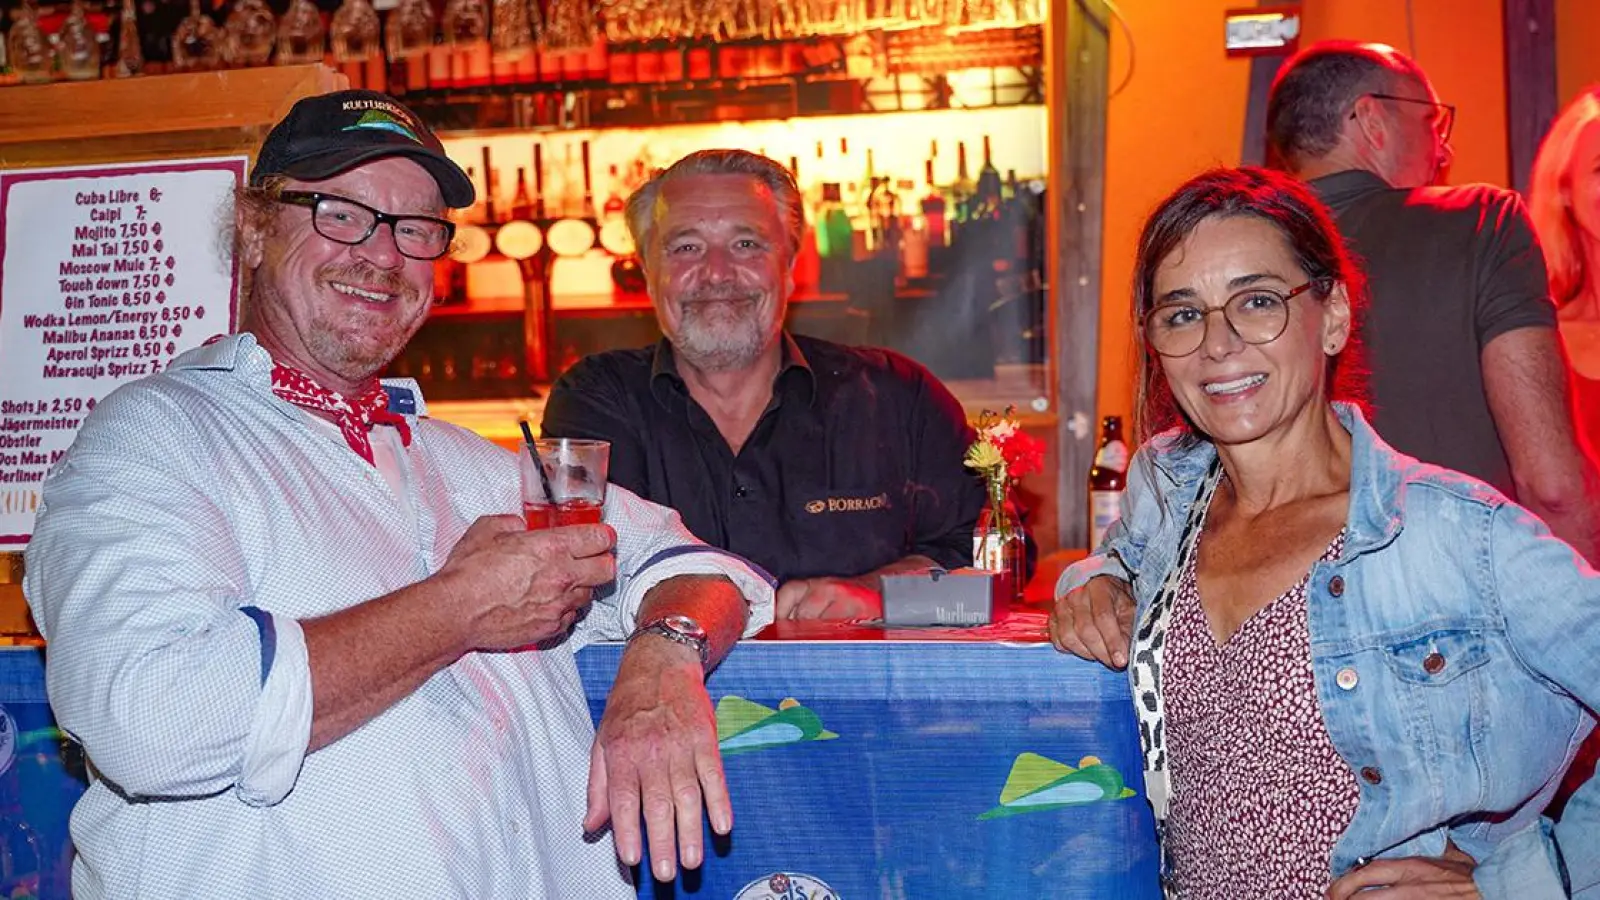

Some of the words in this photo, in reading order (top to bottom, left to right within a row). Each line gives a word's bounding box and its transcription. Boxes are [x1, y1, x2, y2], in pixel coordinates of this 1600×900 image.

[75, 191, 106, 205] Cuba
[109, 190, 139, 202] Libre
[90, 208, 121, 223] Caipi
[75, 226, 116, 241] Mojito
[120, 223, 147, 238] 7,50
[72, 244, 98, 258] Mai
[101, 243, 118, 255] Tai
[122, 241, 150, 255] 7,50
[59, 262, 111, 276] Moscow
[113, 259, 145, 272] Mule
[58, 278, 93, 292] Touch
[96, 276, 129, 291] down
[133, 275, 160, 290] 7,50
[65, 296, 84, 309] Gin
[89, 294, 118, 307] Tonic
[122, 292, 151, 306] 6,50
[24, 314, 65, 328] Wodka
[68, 310, 158, 326] Lemon/Energy
[162, 306, 190, 321] 6,50
[43, 330, 87, 344] Malibu
[90, 328, 135, 342] Ananas
[139, 325, 167, 340] 6,50
[47, 347, 87, 363] Aperol
[91, 345, 128, 361] Sprizz
[133, 343, 160, 358] 6,50
[43, 364, 105, 380] Maracuja
[108, 364, 146, 378] Sprizz
[1, 400, 33, 414] Shots
[35, 400, 47, 415] je
[52, 398, 82, 413] 2,50
[0, 417, 80, 433] Jägermeister
[0, 435, 42, 448] Obstler
[20, 451, 47, 465] Mas
[936, 602, 988, 623] Marlboro
